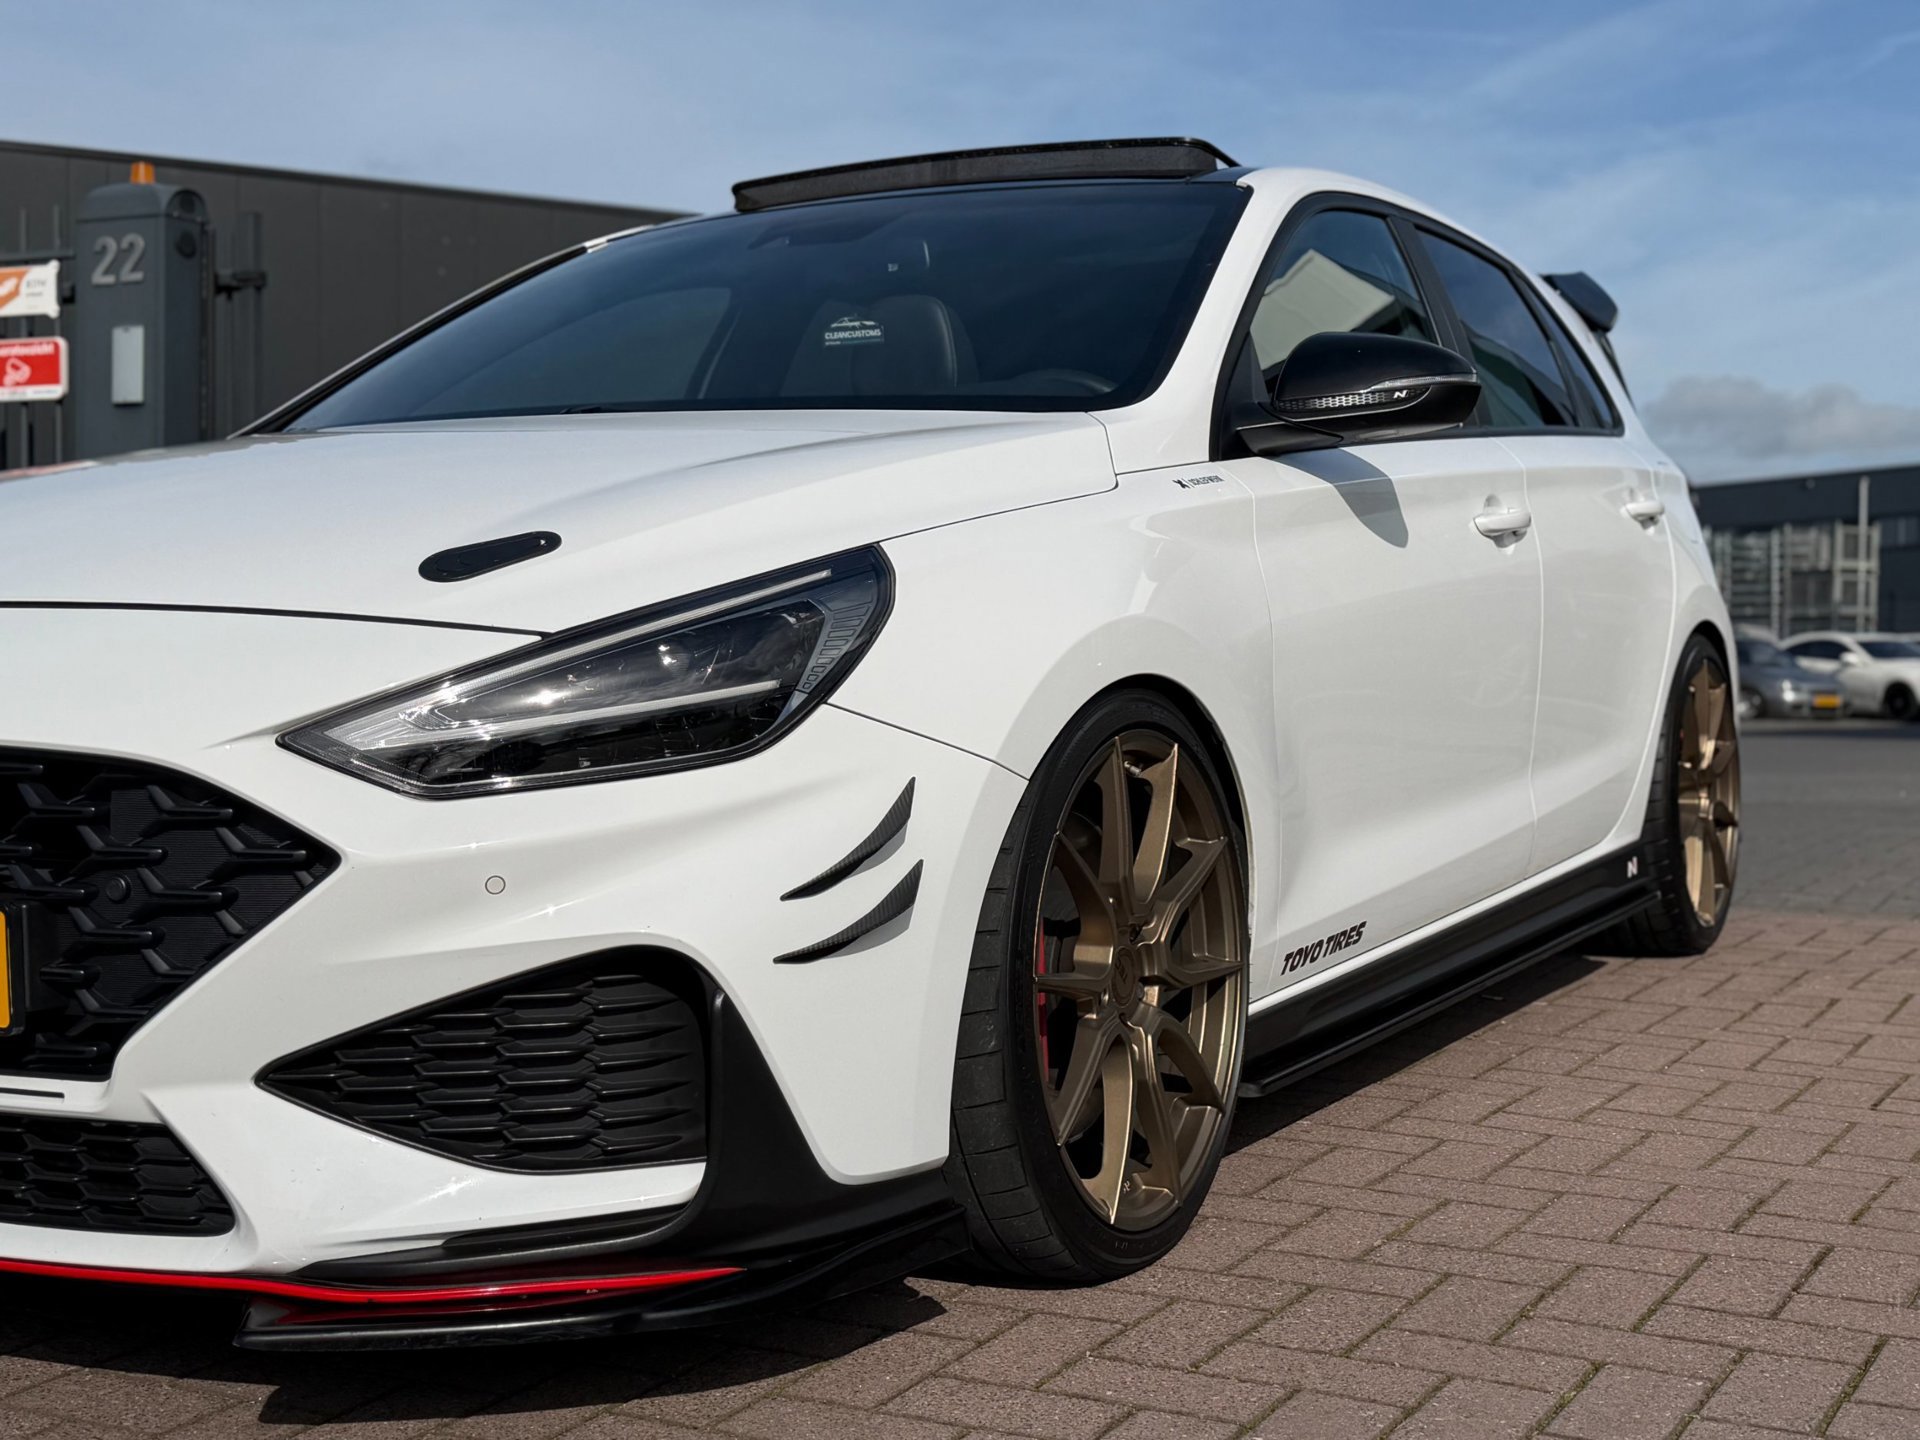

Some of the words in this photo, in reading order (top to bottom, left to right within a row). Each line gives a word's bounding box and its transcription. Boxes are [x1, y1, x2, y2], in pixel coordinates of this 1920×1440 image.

[91, 233, 145, 285] 22
[824, 329, 882, 339] CLEANCUSTOMS
[1393, 390, 1408, 399] N
[1627, 856, 1638, 878] N
[1280, 939, 1324, 976] TOYO
[1323, 921, 1367, 958] TIRES
